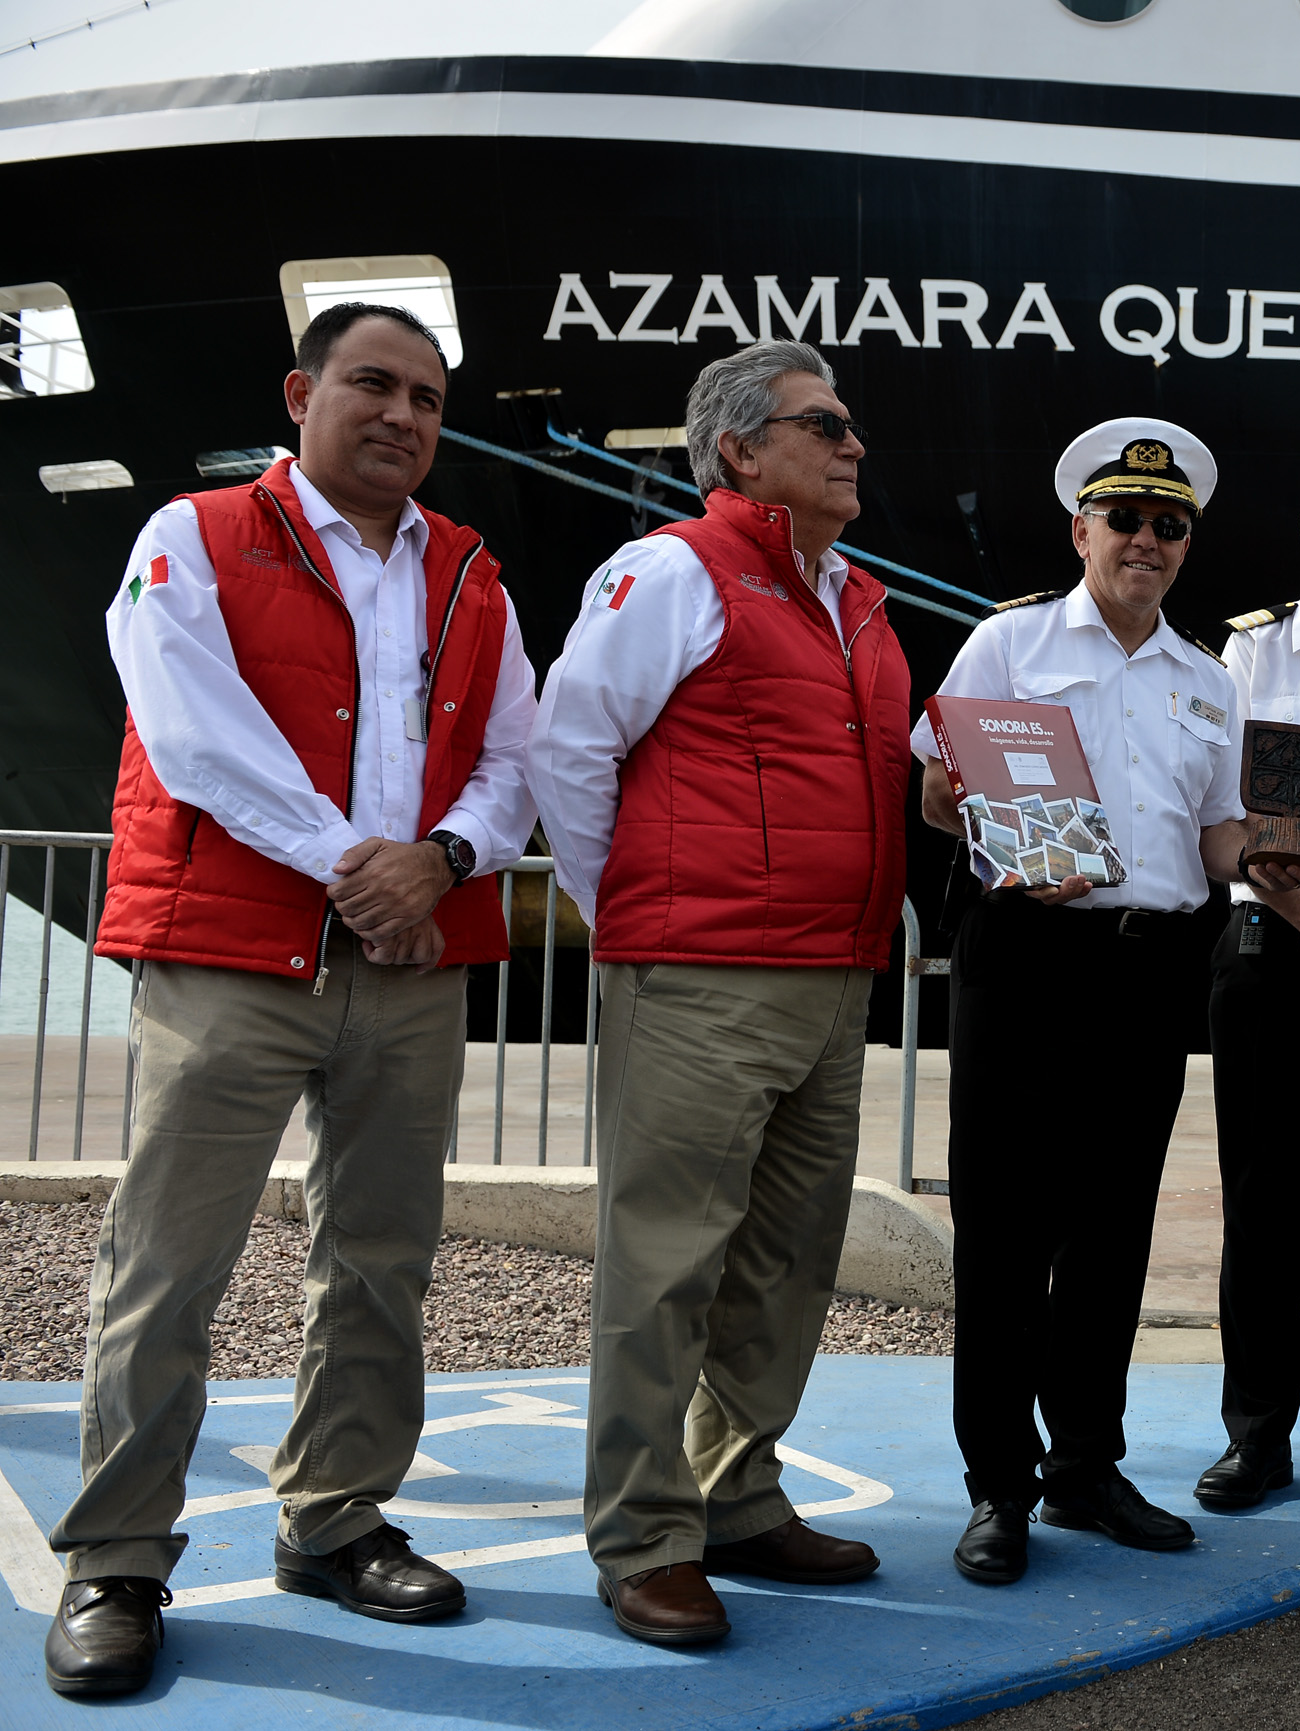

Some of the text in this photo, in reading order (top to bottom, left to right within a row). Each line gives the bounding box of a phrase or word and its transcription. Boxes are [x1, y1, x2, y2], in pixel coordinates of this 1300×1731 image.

[543, 271, 1075, 352] AZAMARA
[251, 547, 274, 558] SCT
[740, 572, 762, 585] SCT
[978, 718, 1031, 735] SONORA
[1029, 738, 1055, 747] desarrollo
[939, 741, 954, 773] SONORA
